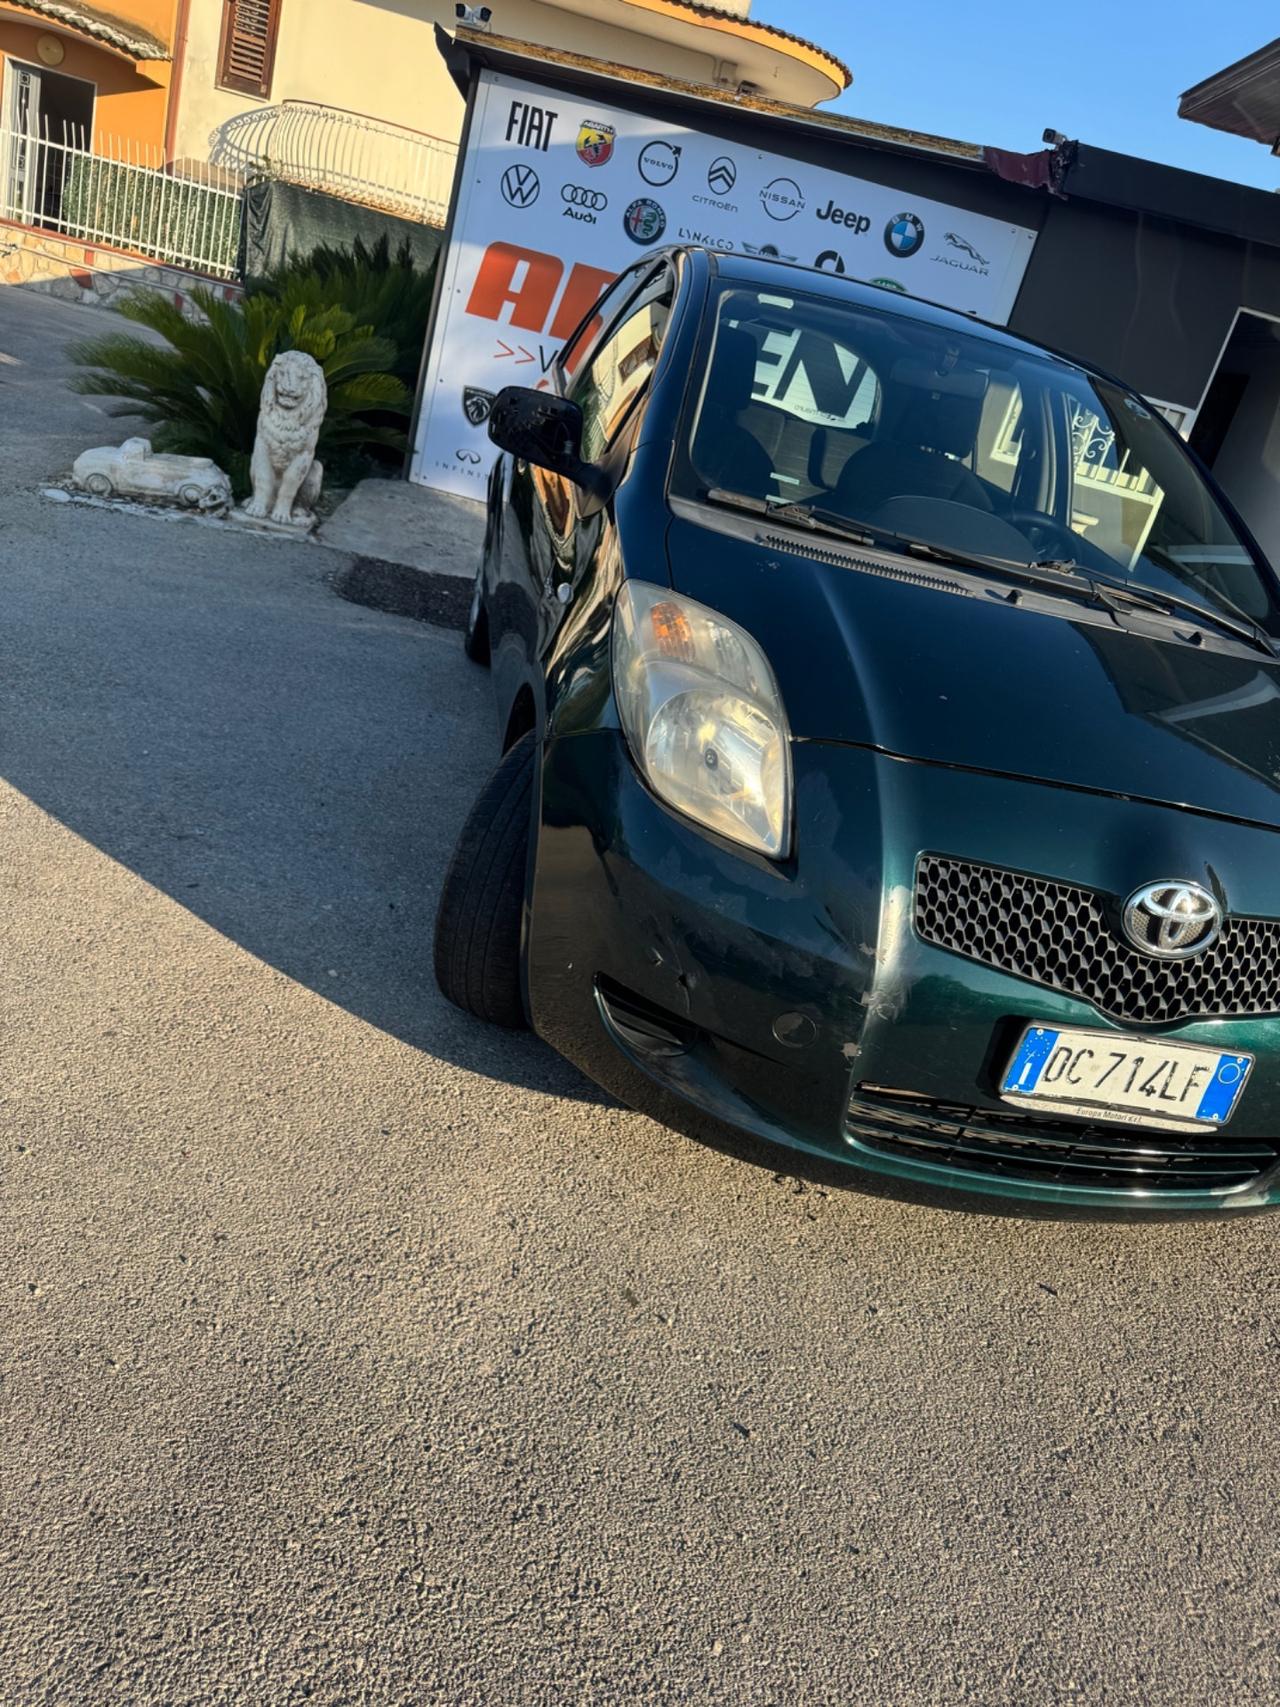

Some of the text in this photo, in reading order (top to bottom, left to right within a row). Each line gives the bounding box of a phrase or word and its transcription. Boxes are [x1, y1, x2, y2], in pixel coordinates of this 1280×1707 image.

[505, 100, 558, 152] FIAT
[643, 157, 673, 170] VOLVO
[758, 188, 806, 210] NISSAN
[562, 206, 597, 225] Audi
[816, 200, 871, 235] Jeep
[890, 213, 924, 232] BMW
[929, 256, 989, 276] JAGUAR
[1042, 1046, 1212, 1102] DC 714LF
[1103, 1110, 1127, 1121] Motori
